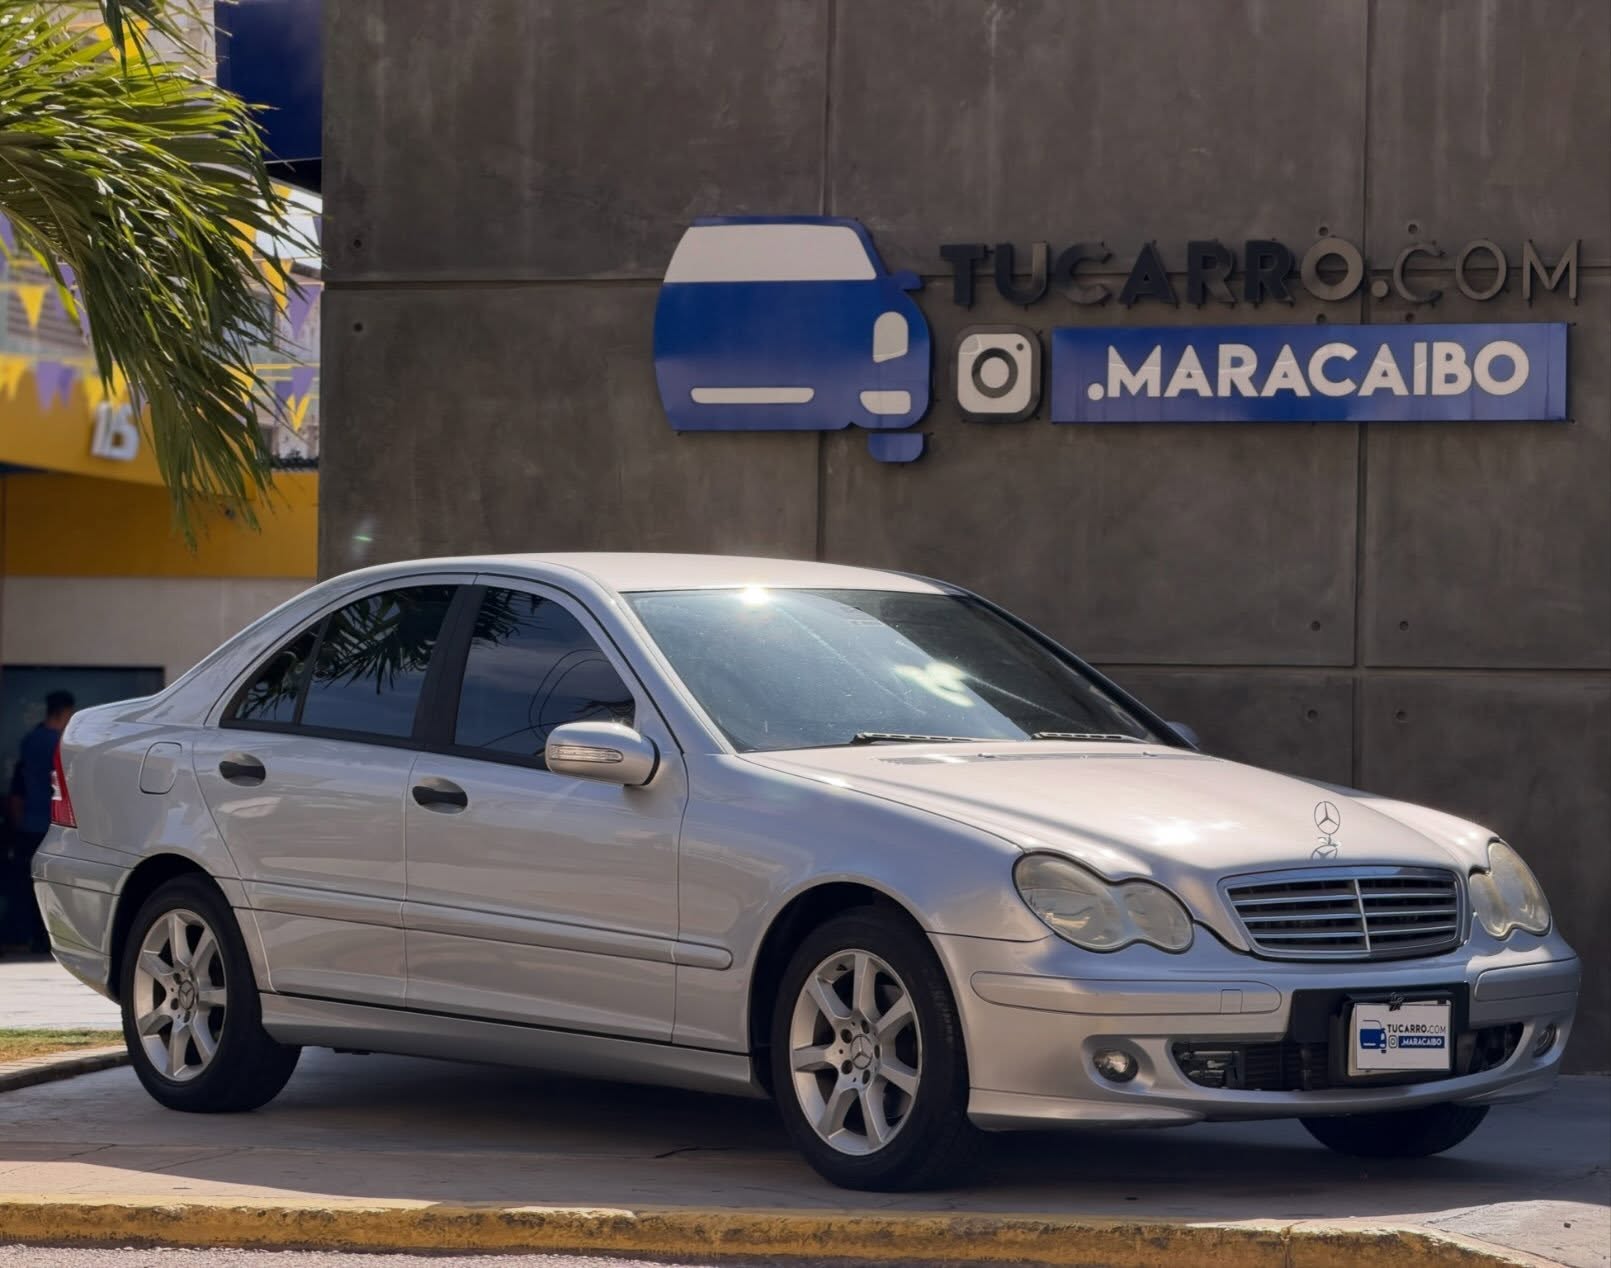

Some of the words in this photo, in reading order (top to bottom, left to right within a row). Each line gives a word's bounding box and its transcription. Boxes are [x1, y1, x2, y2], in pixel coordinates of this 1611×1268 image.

[940, 238, 1579, 305] TUCARRO.COM
[1087, 340, 1530, 400] .MARACAIBO
[1387, 1024, 1446, 1034] TUCARRO.COM
